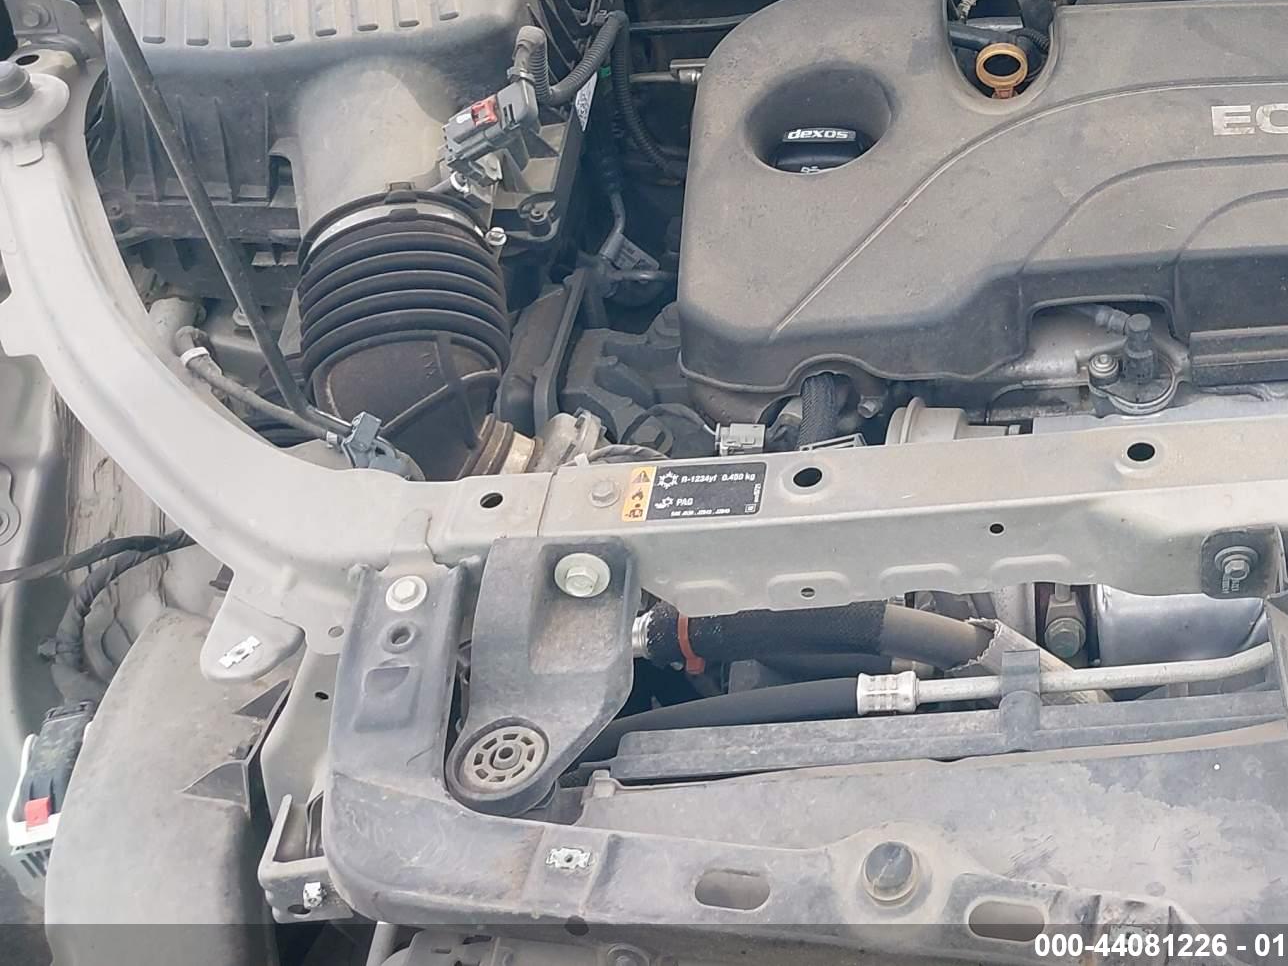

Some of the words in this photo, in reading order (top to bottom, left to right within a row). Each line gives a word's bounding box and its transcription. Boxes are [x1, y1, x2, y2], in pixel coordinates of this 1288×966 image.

[787, 129, 849, 140] dexos
[681, 474, 718, 484] R-1234yf
[745, 472, 756, 482] kg
